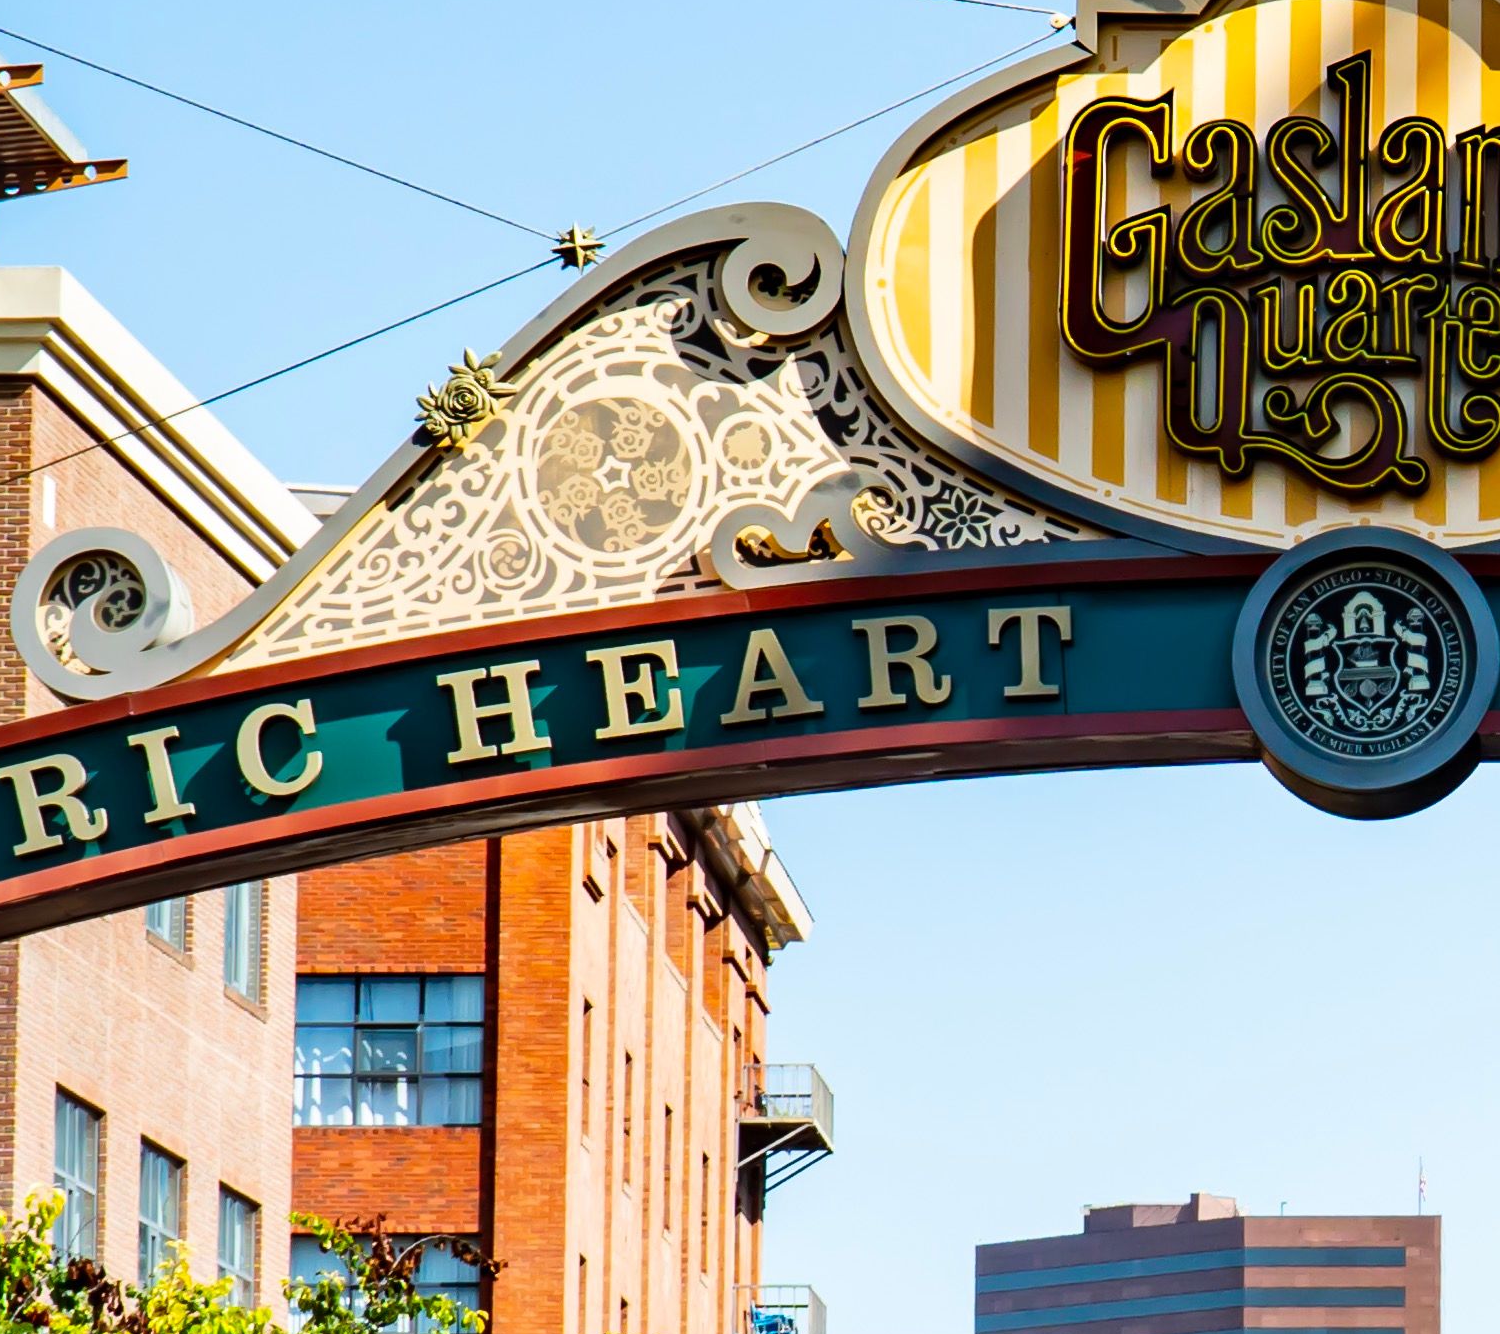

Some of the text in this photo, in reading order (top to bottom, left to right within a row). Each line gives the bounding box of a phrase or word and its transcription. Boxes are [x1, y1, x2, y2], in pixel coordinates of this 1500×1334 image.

[1313, 570, 1362, 594] DIEGO
[1375, 570, 1421, 597] STATE
[1286, 593, 1311, 624] SAN
[1426, 597, 1445, 618] OF
[1275, 624, 1290, 647] OF
[1272, 650, 1288, 690] CITY
[1435, 620, 1462, 714] CALIFORNIA
[443, 603, 1077, 767] HEART
[1312, 727, 1427, 755] SEMPER VIGILANS
